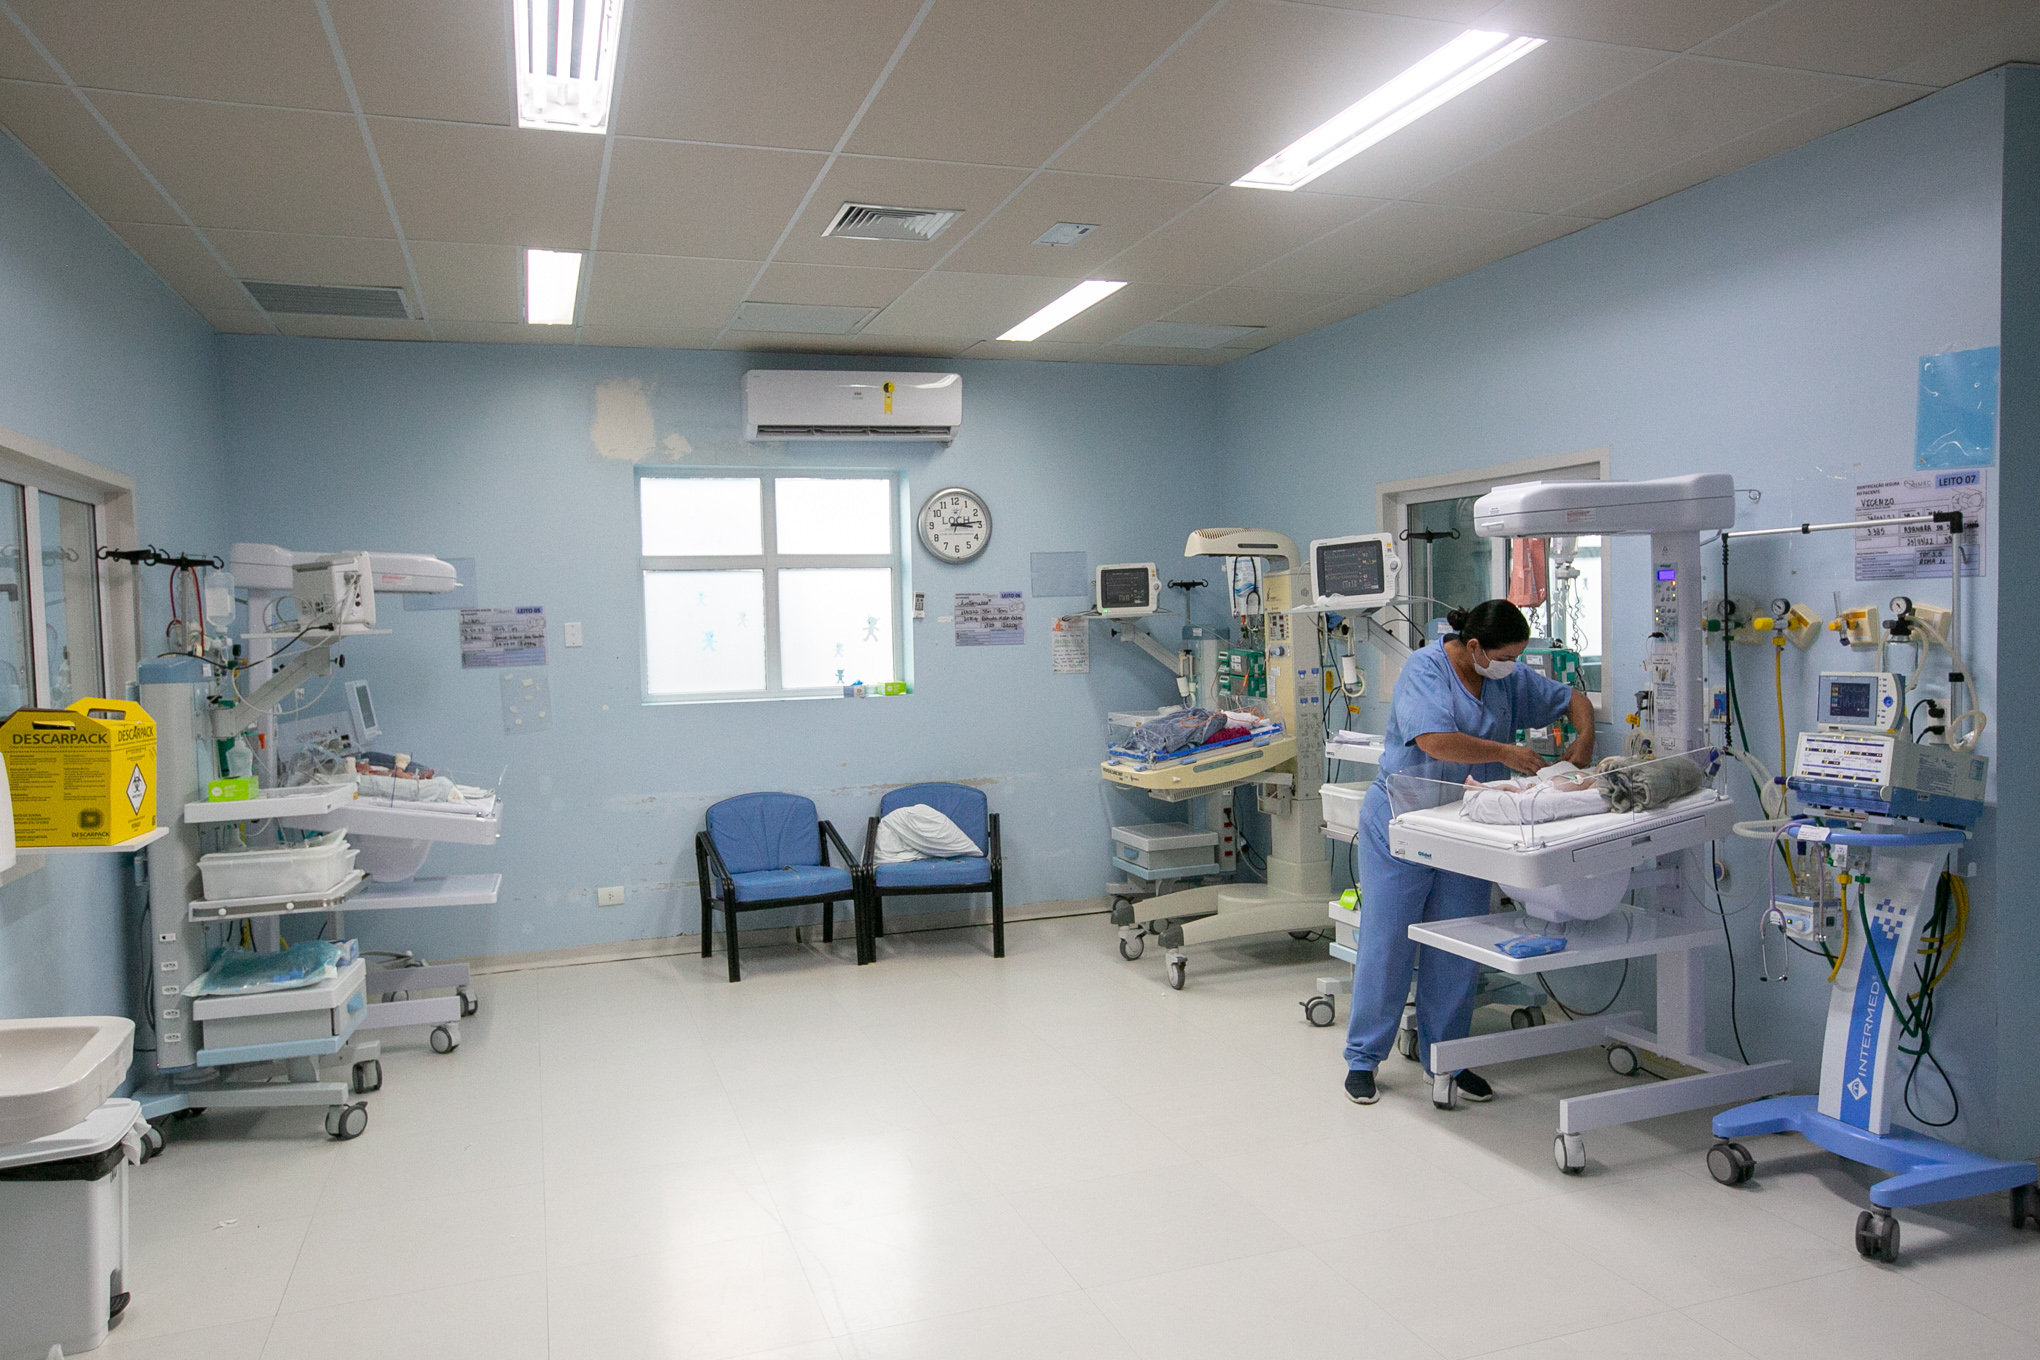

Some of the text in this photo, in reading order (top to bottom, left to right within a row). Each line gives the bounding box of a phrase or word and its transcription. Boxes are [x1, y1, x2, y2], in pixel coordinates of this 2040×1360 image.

[1939, 475, 1976, 487] LEITO 07
[940, 501, 947, 509] 11
[951, 497, 960, 506] 12
[933, 509, 942, 517] 10
[973, 508, 979, 517] 2
[929, 521, 935, 530] 9
[934, 533, 940, 542] 8
[974, 533, 979, 541] 4
[943, 542, 949, 550] 7
[955, 544, 960, 553] 6
[966, 541, 972, 549] 5
[117, 726, 154, 742] DESCARPACK
[12, 733, 108, 745] DESCARPACK
[1857, 980, 1880, 1077] INTERMED
